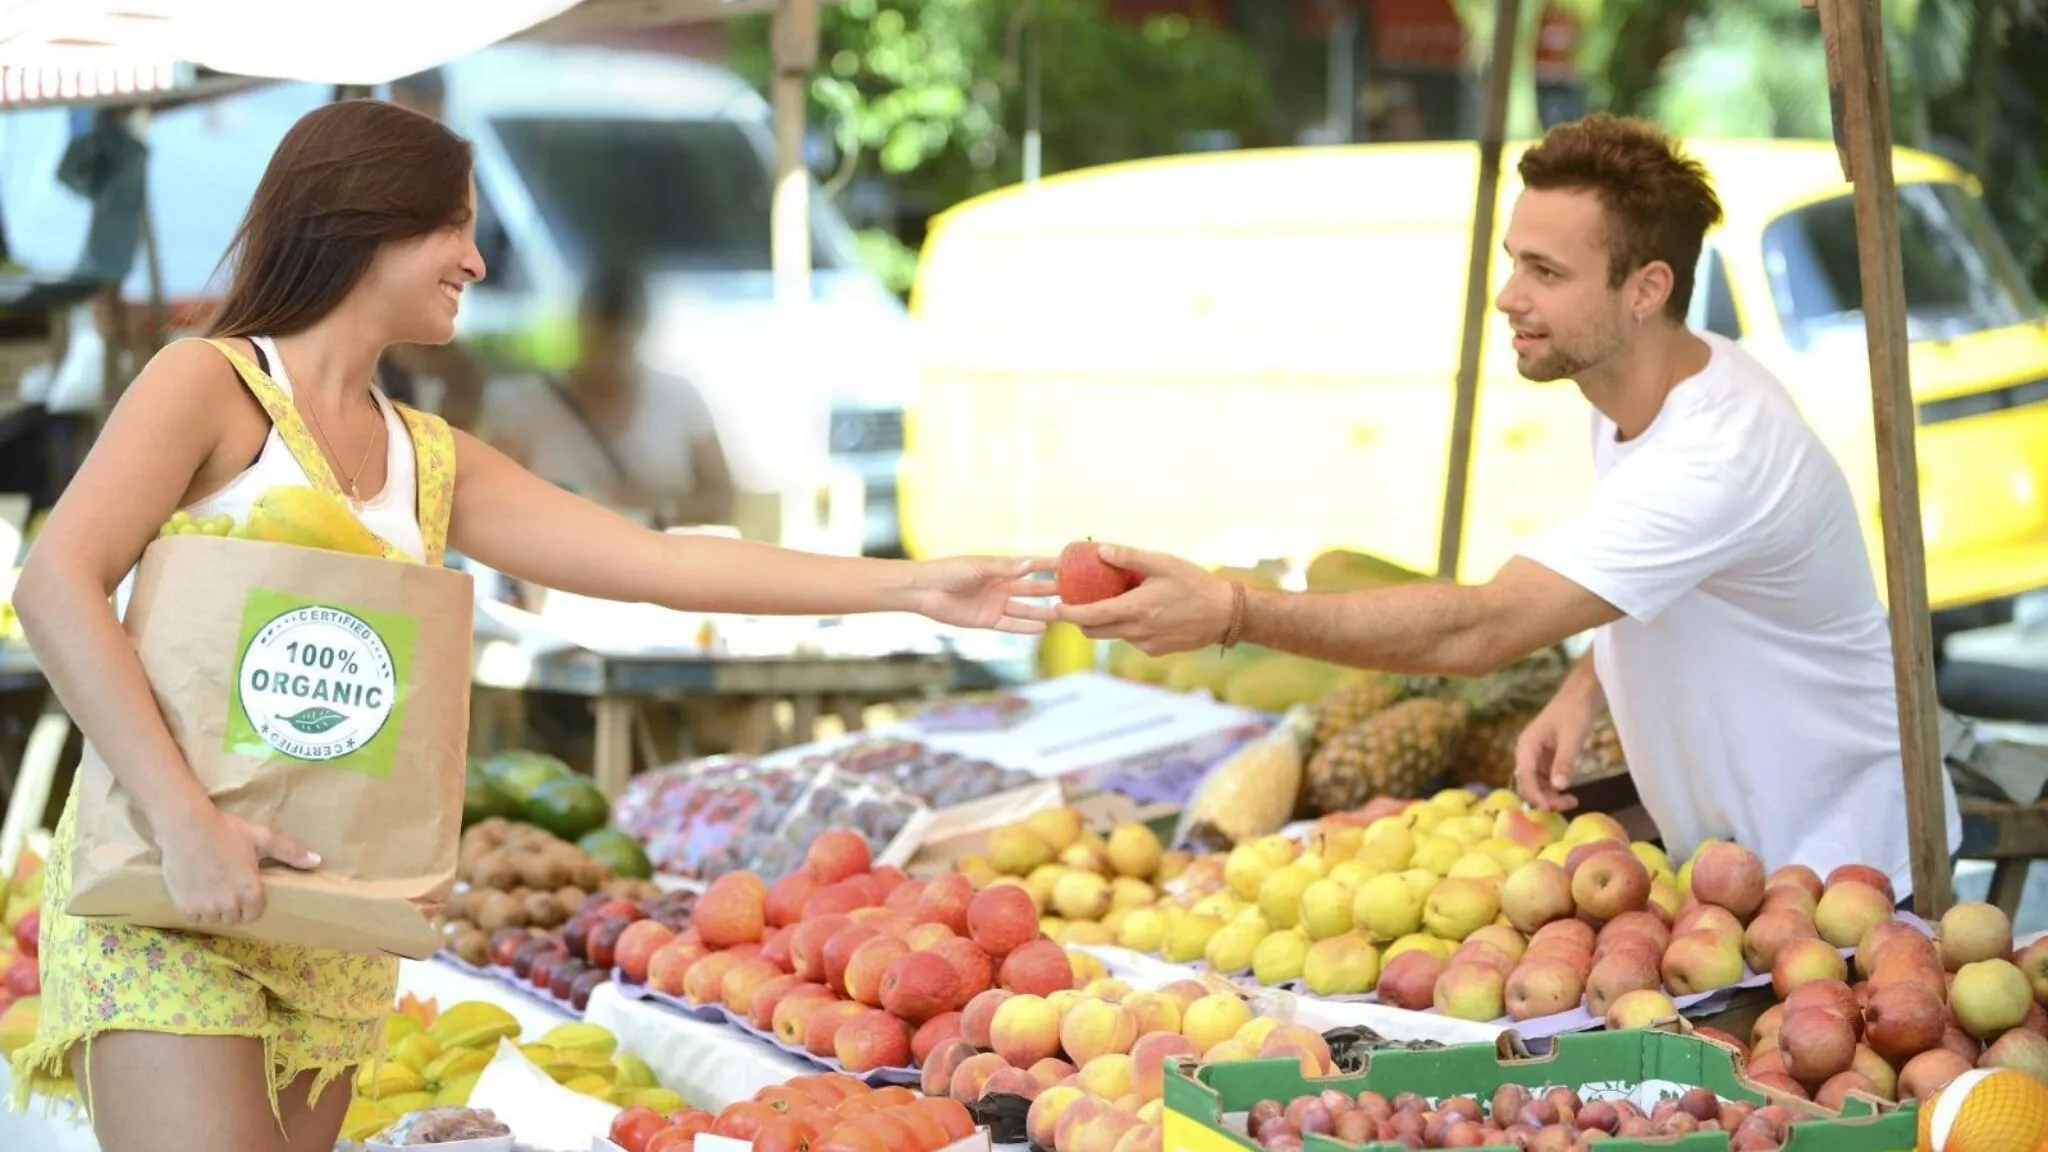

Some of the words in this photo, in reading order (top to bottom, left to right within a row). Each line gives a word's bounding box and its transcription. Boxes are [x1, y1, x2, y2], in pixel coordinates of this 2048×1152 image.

[299, 610, 371, 640] CERTIFIED
[286, 641, 358, 675] 100%
[251, 668, 383, 709] ORGANIC
[270, 732, 343, 756] CERTIFIED
